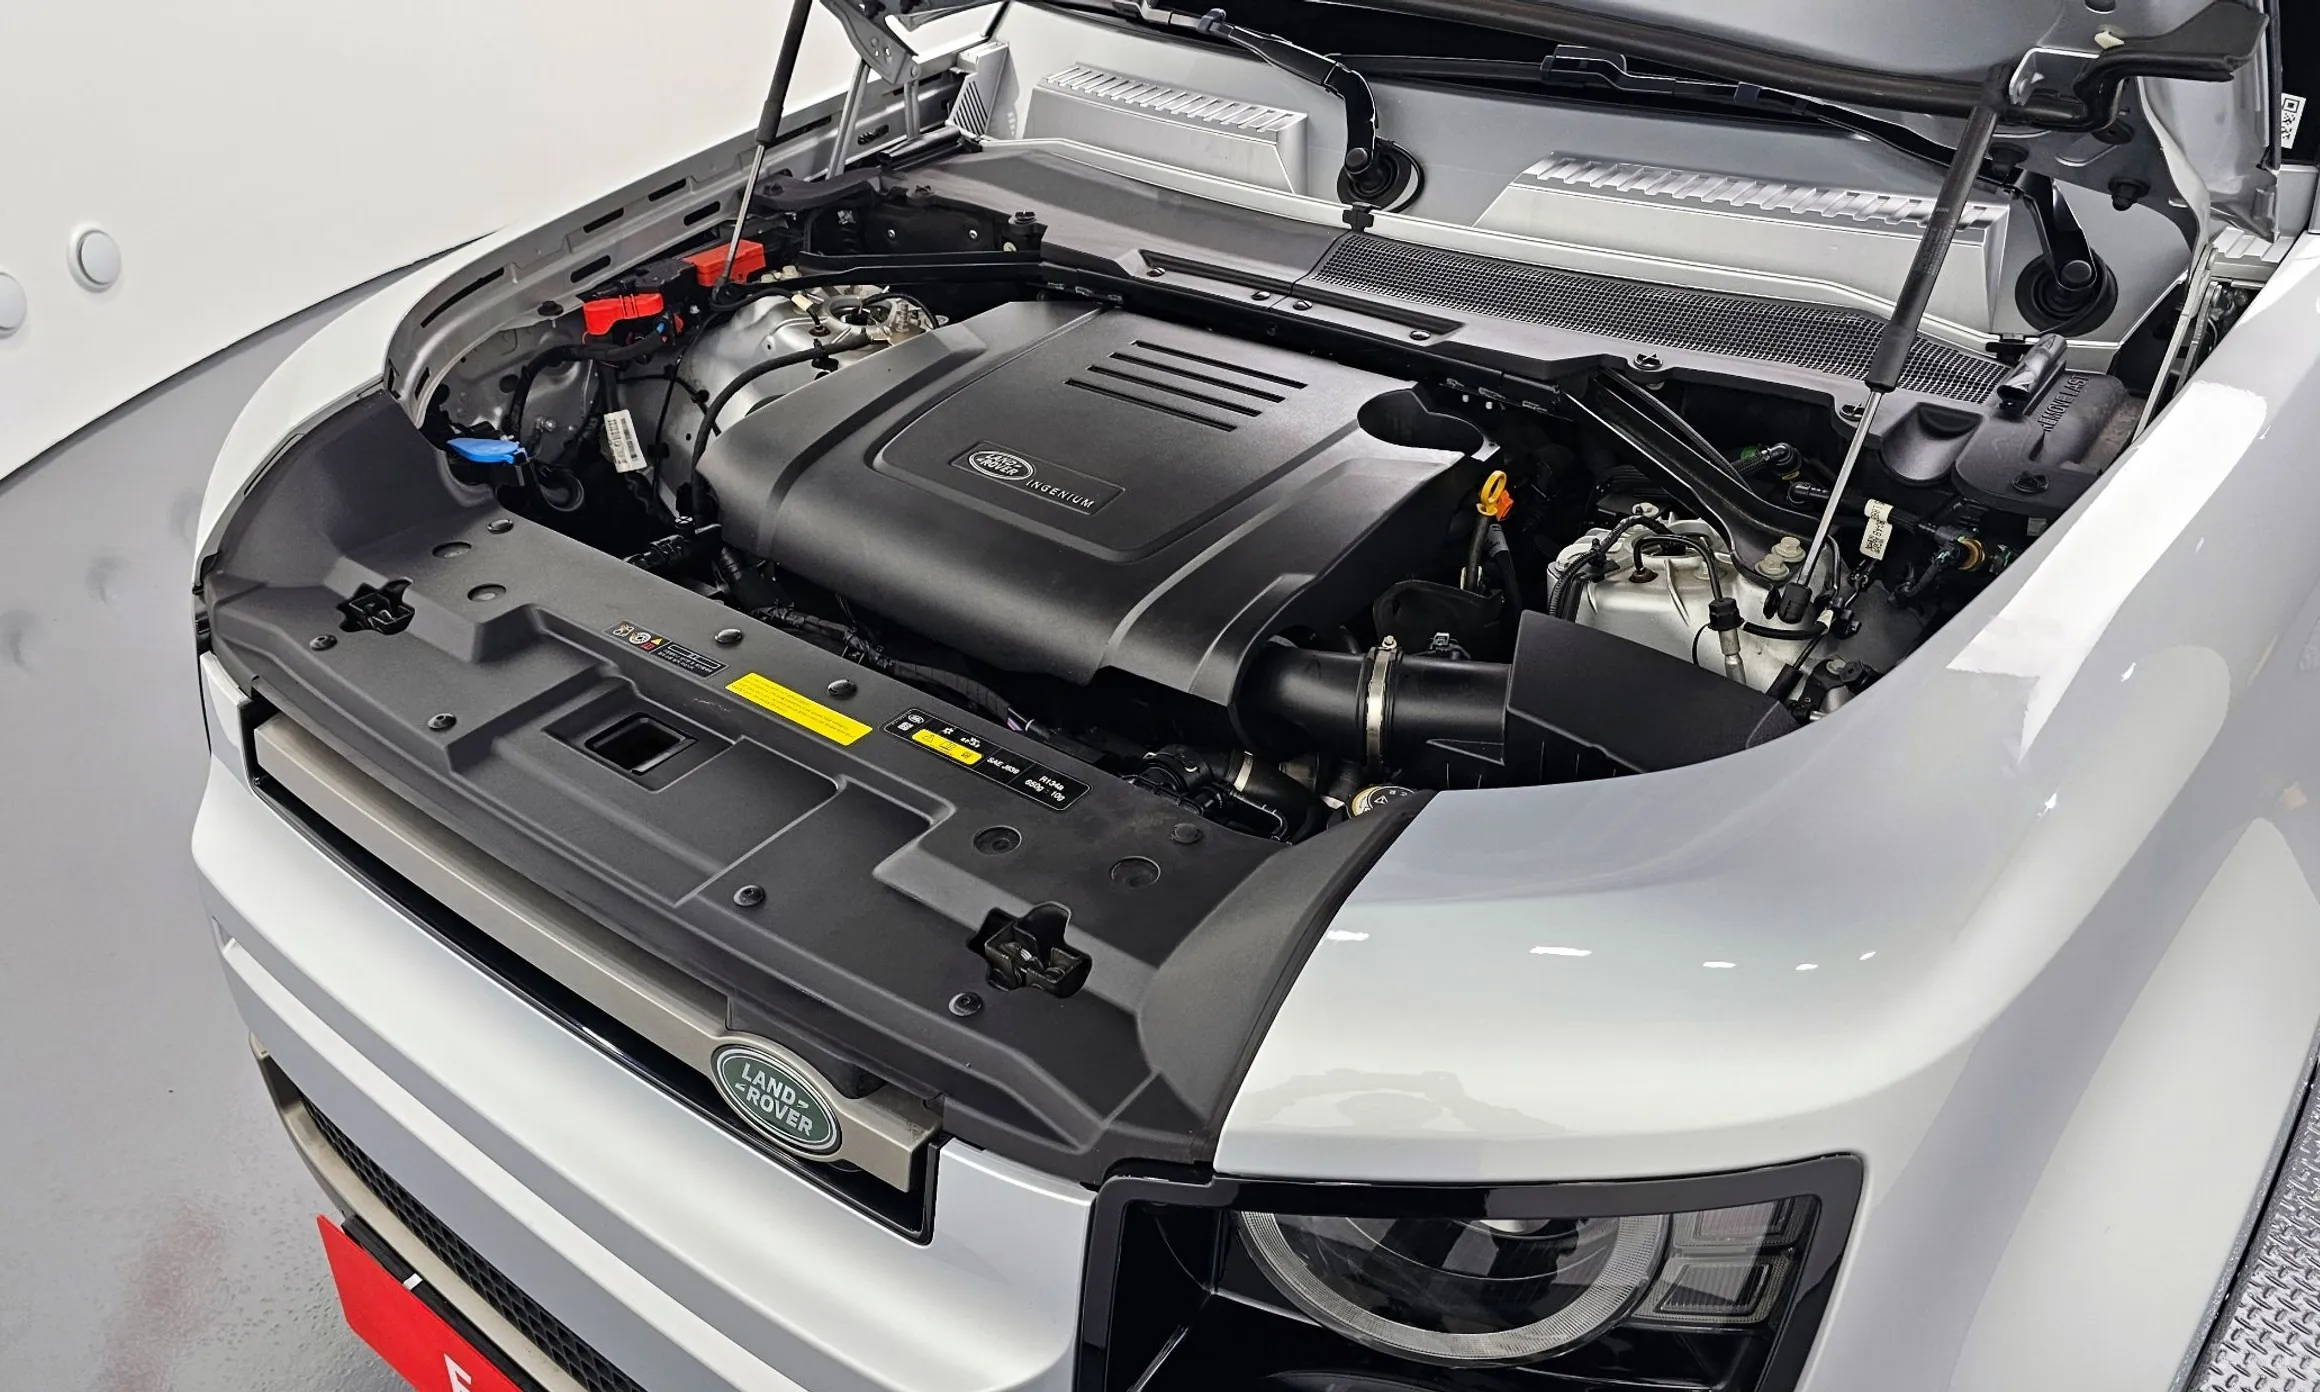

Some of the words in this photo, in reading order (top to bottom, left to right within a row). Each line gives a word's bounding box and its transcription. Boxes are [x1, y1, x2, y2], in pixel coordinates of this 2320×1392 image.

[979, 459, 1019, 476] ROVER
[985, 453, 1017, 466] LAND
[1025, 478, 1096, 509] INGENIUM
[741, 1062, 796, 1106] LAND
[746, 1085, 813, 1137] ROVER
